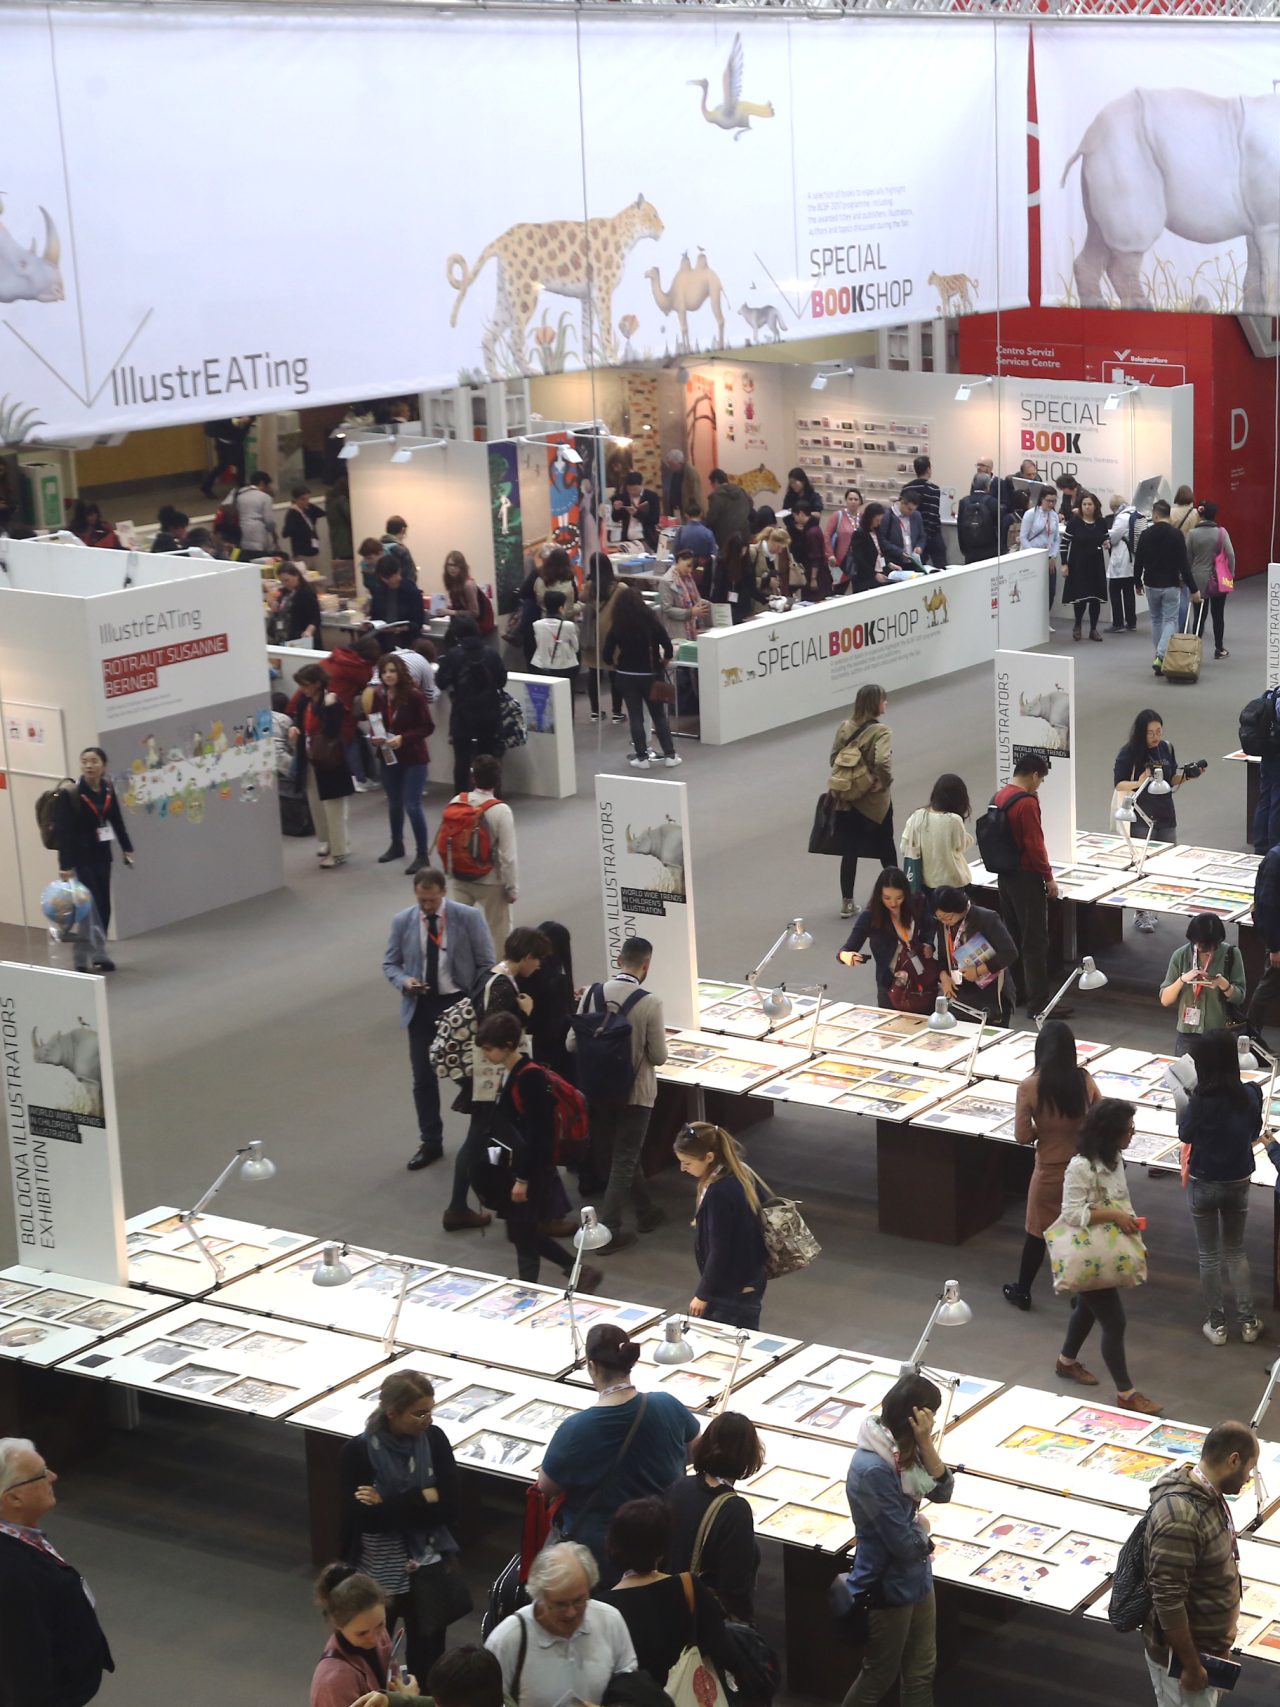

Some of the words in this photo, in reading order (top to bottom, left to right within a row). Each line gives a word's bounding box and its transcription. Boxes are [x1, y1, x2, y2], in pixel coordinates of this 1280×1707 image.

[810, 242, 887, 278] SPECIAL
[810, 278, 913, 318] BOOKSHOP
[996, 346, 1025, 355] Centro
[1026, 347, 1055, 357] Servizi
[996, 357, 1030, 367] Services
[1031, 358, 1061, 368] Centre
[111, 351, 310, 406] IllustrEATing
[1021, 399, 1107, 426] SPECIAL
[1230, 407, 1249, 450] D
[1021, 430, 1082, 454] BOOK
[1035, 460, 1078, 482] HOP
[99, 609, 201, 645] IllustrEATing
[757, 635, 828, 678] SPECIAL
[828, 608, 919, 657] BOOKSHOP
[1269, 582, 1280, 669] ILLUSTRATORS
[103, 649, 165, 677] ROTRAUT
[166, 636, 226, 663] SUSANNE
[104, 671, 157, 697] BERNER
[998, 672, 1011, 774] ILLUSTRATORS
[600, 801, 620, 920] ILLUSTRATORS
[0, 997, 28, 1146] ILLUSTRATORS
[15, 1153, 36, 1246] BOLOGNA
[32, 1140, 56, 1250] EXHIBITION
